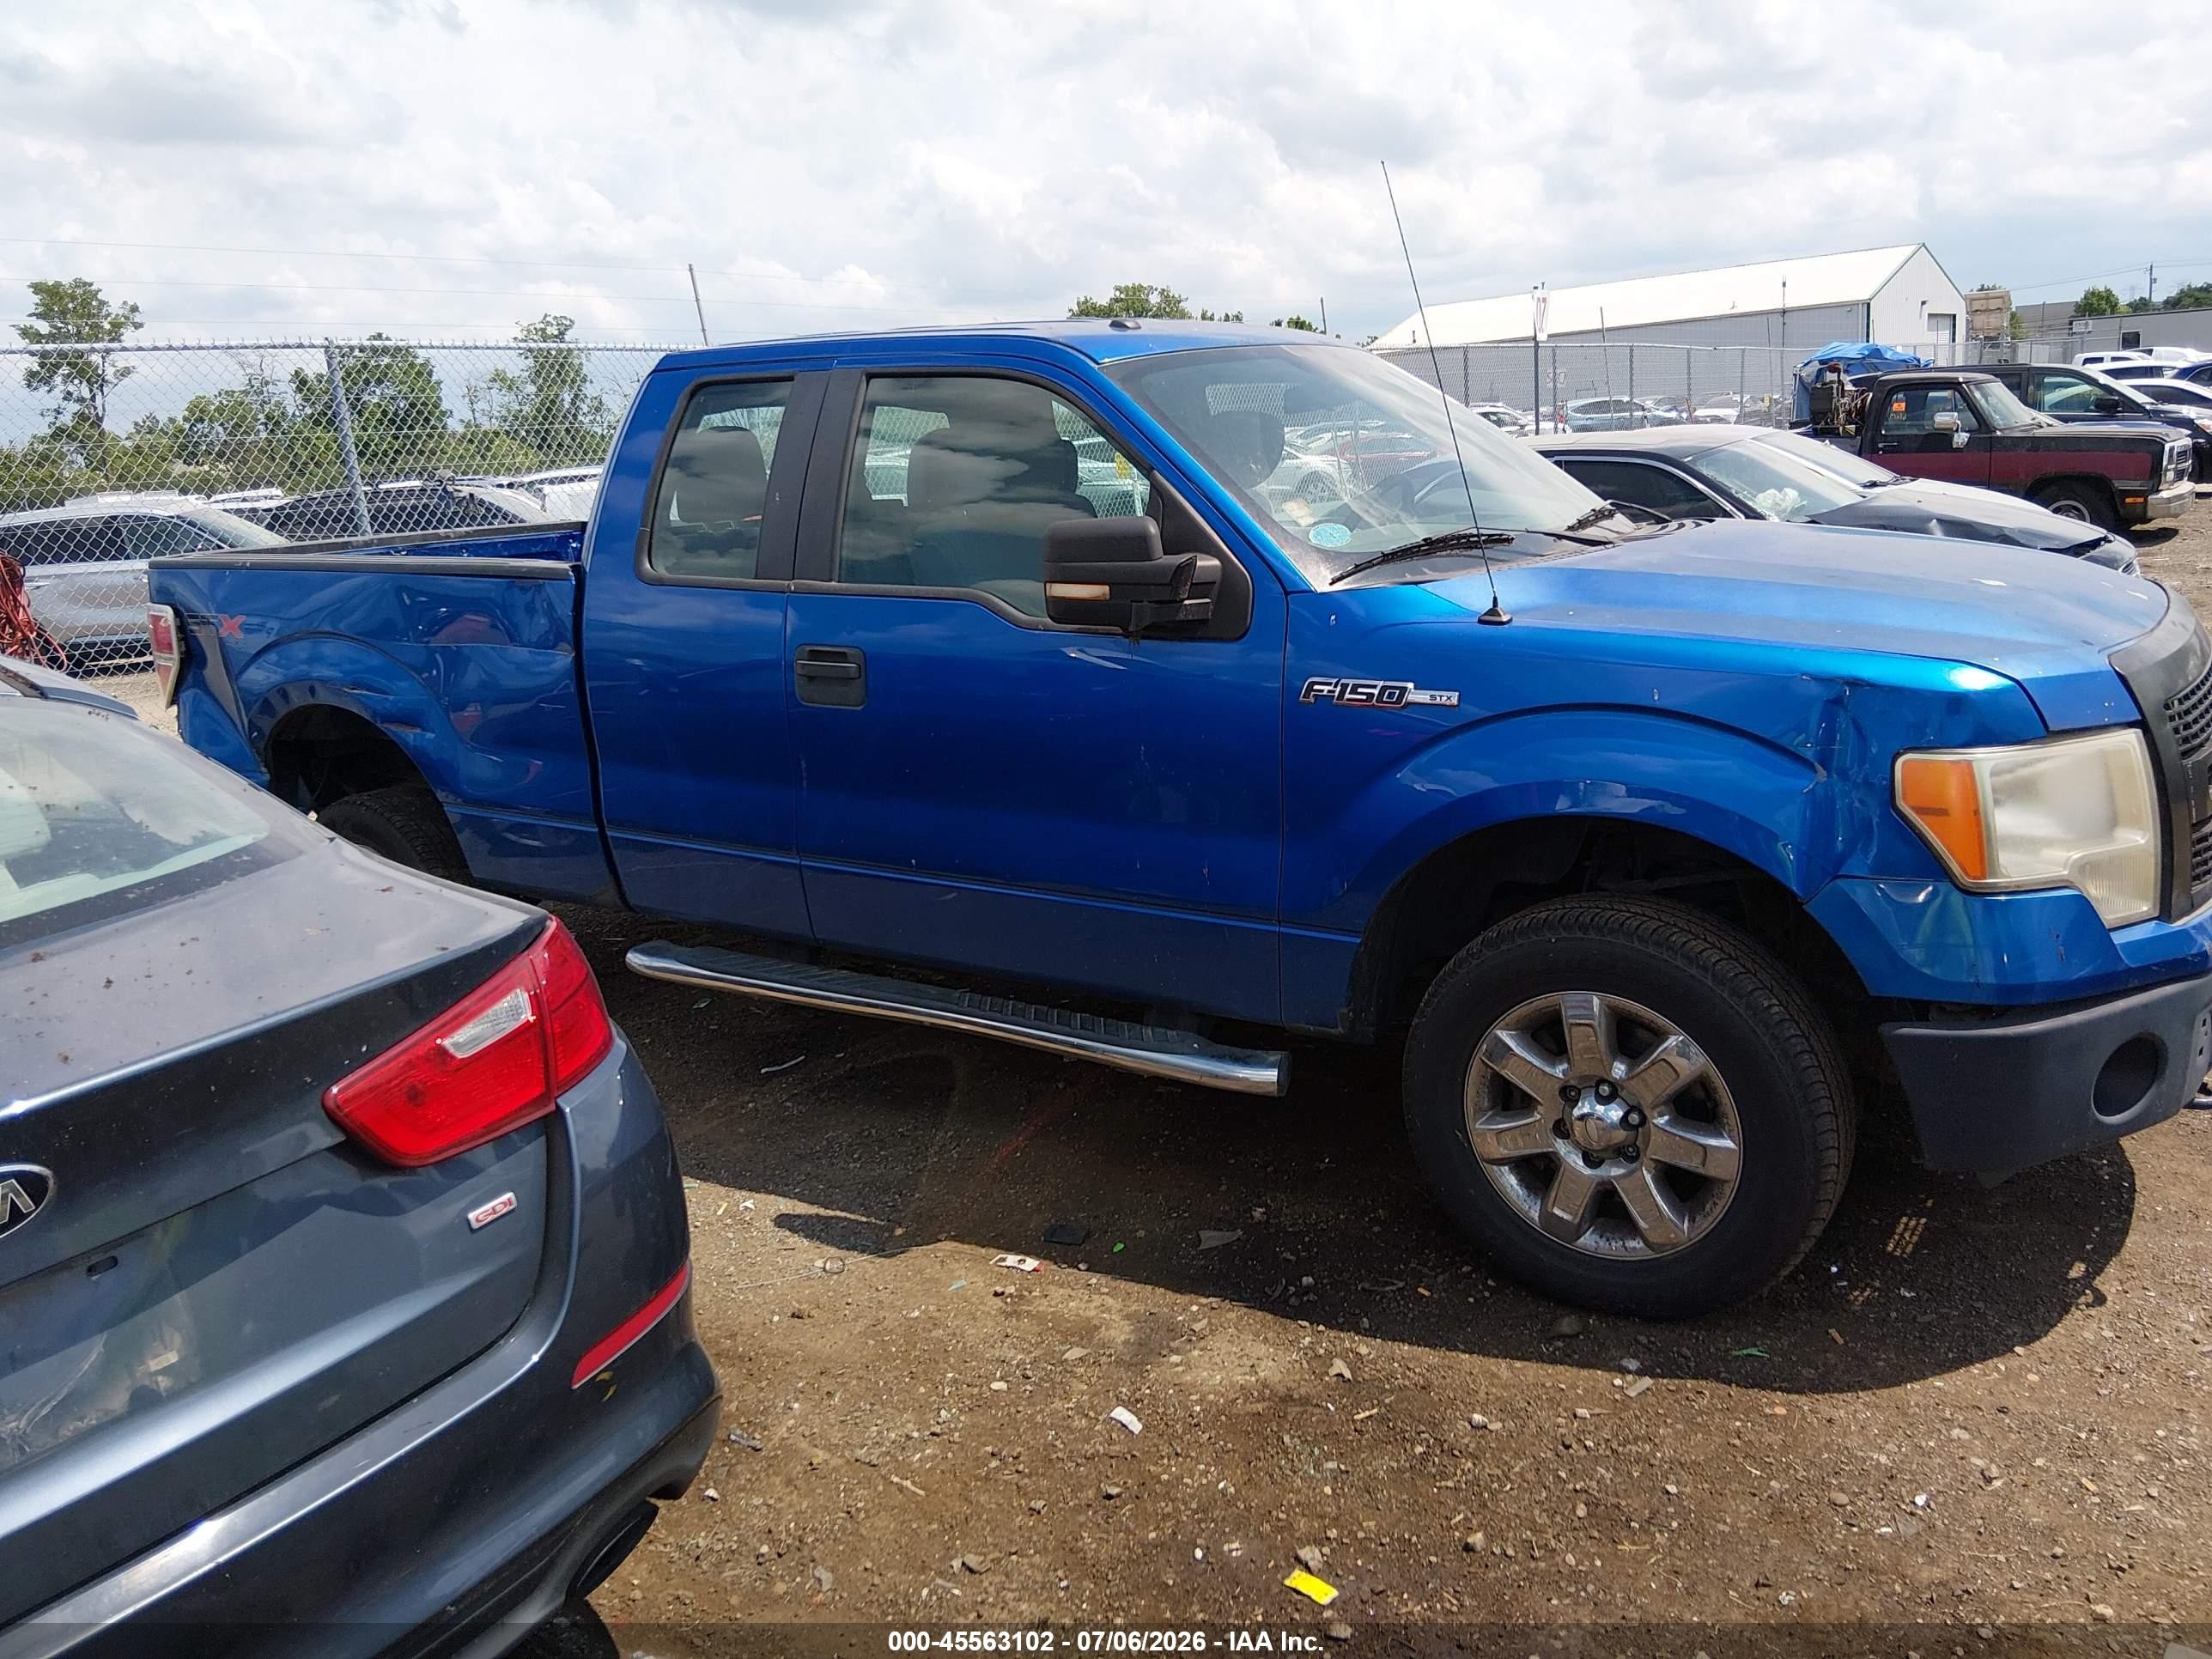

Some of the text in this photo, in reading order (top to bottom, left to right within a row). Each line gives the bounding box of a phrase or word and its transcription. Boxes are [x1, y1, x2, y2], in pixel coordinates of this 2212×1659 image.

[1299, 677, 1453, 707] F-150 STX
[474, 1197, 514, 1224] GDI
